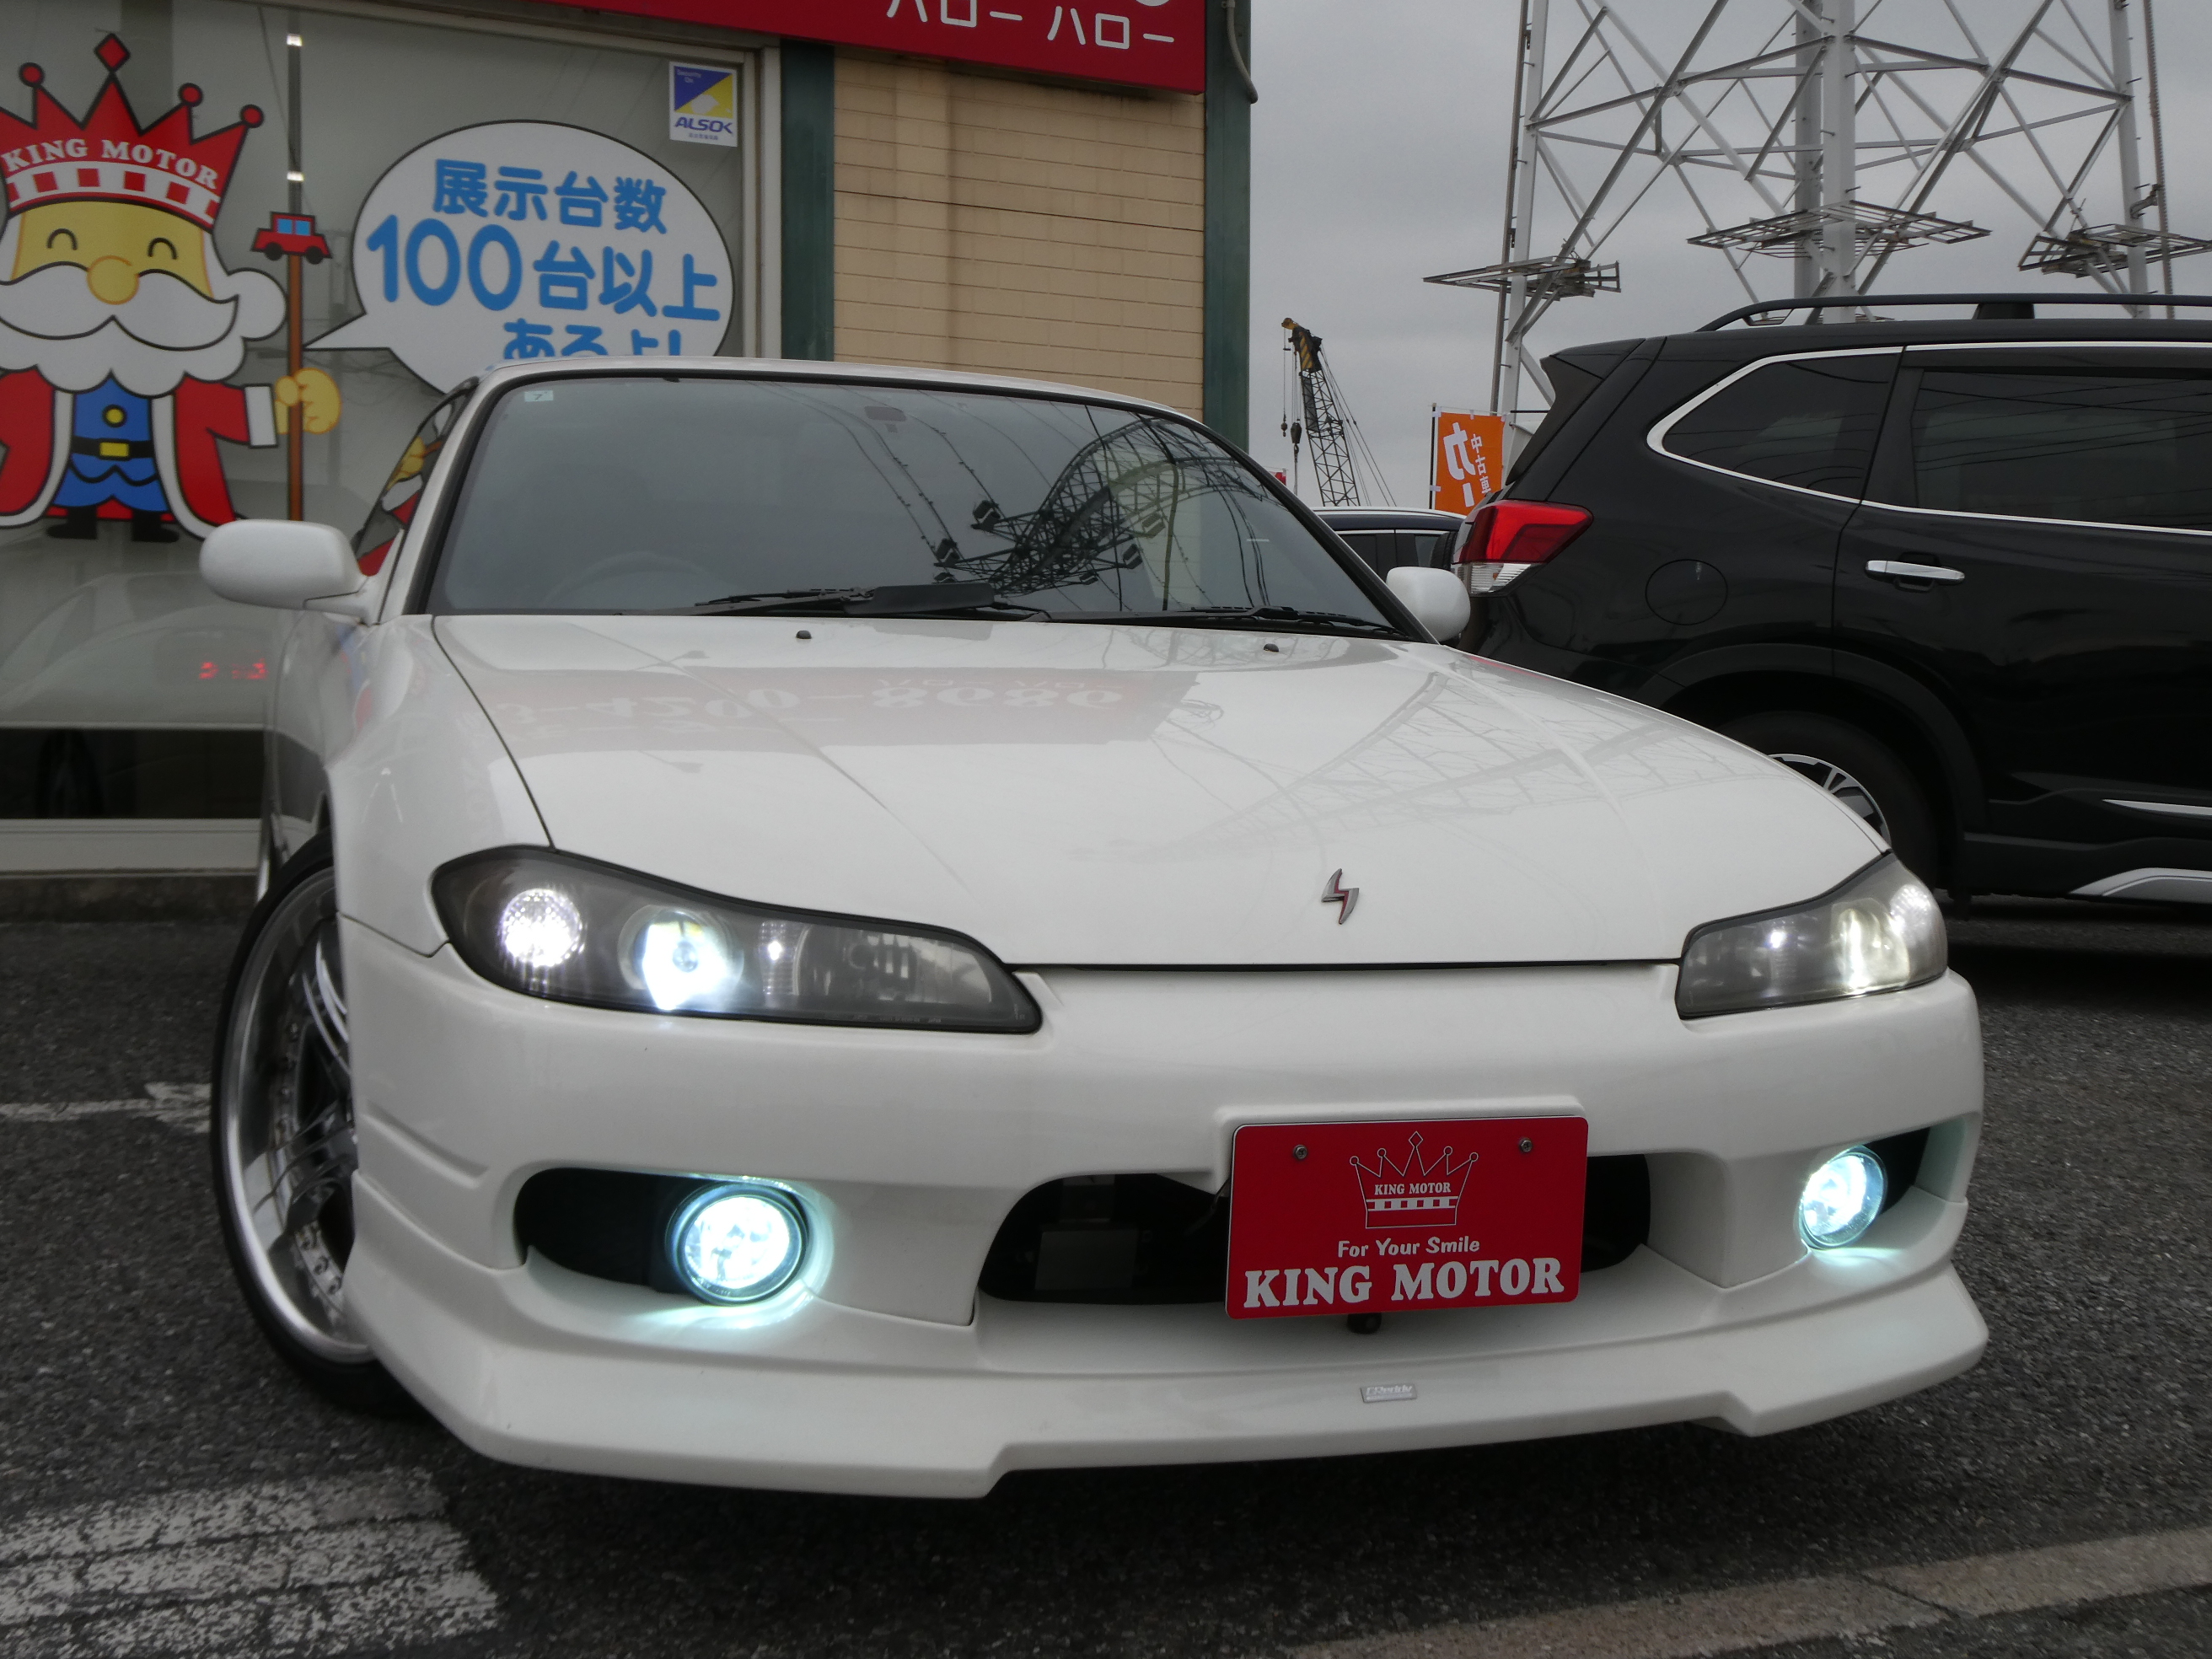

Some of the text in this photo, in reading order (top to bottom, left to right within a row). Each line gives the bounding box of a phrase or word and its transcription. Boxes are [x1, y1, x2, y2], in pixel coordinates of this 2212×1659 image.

[1047, 6, 1174, 49] ハロー
[674, 116, 733, 134] ALSOK
[1, 138, 219, 190] KING MOTOR
[432, 158, 667, 234] 展示台数
[367, 214, 721, 321] 100台以上
[1374, 1182, 1452, 1195] KING MOTOR
[1338, 1236, 1479, 1258] For Your Smile
[1243, 1258, 1565, 1308] KING MOTOR
